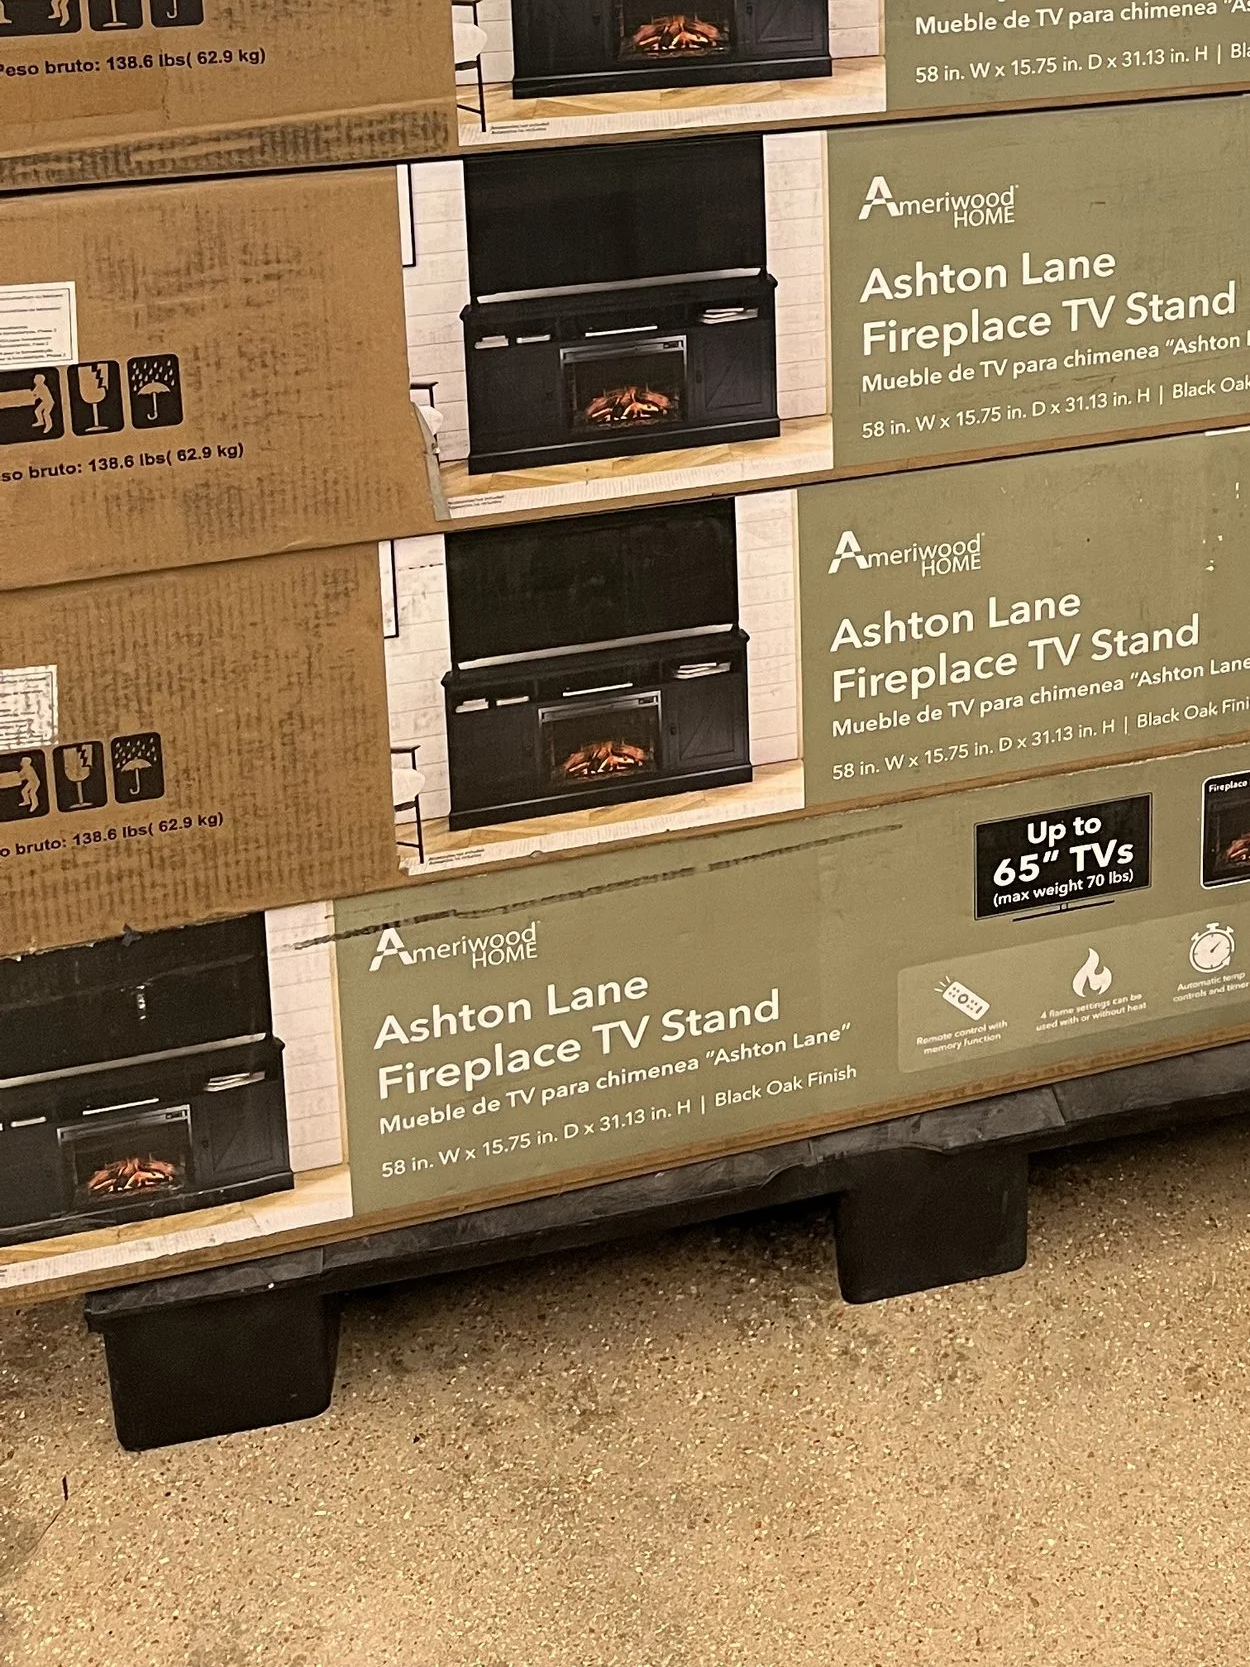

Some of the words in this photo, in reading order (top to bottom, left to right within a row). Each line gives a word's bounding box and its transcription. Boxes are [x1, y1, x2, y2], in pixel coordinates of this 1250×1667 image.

[916, 12, 997, 34] Mueble
[1004, 10, 1030, 28] de
[1035, 8, 1063, 26] TV
[1069, 4, 1113, 29] para
[1121, 2, 1217, 20] chimenea
[45, 59, 100, 74] bruto:
[107, 55, 153, 70] 138.6
[197, 50, 232, 64] 62.9
[239, 48, 265, 64] kg)
[916, 66, 938, 83] 58
[945, 66, 964, 80] in.
[970, 62, 990, 78] W
[995, 66, 1005, 77] x
[1011, 58, 1057, 75] 15.75
[1063, 57, 1082, 71] in.
[1089, 54, 1102, 69] D
[1107, 57, 1117, 68] x
[1122, 49, 1164, 67] 31.13
[1171, 48, 1189, 63] in.
[1196, 46, 1207, 61] H
[859, 176, 1014, 220] Ameriwood
[953, 205, 1015, 228] HOME
[860, 262, 1006, 302] Ashton
[1023, 253, 1115, 285] Lane
[864, 309, 1051, 356] Fireplace
[1062, 296, 1115, 331] TV
[1126, 281, 1235, 325] Stand
[863, 367, 942, 392] Mueble
[949, 363, 974, 382] de
[980, 359, 1007, 377] TV
[1014, 358, 1057, 379] para
[1064, 346, 1158, 368] chimenea
[29, 464, 81, 478] bruto:
[88, 455, 134, 472] 138.6
[177, 447, 211, 461] 62.9
[217, 442, 243, 459] kg)
[828, 531, 982, 575] Ameriwood
[921, 556, 982, 578] HOME
[830, 610, 973, 652] Ashton
[989, 594, 1080, 628] Lane
[833, 652, 1017, 702] Fireplace
[1028, 634, 1080, 669] TV
[1091, 613, 1198, 660] Stand
[1209, 780, 1247, 792] Fireplace
[16, 839, 66, 855] bruto:
[72, 828, 117, 847] 138.6
[159, 817, 192, 832] 62.9
[198, 812, 223, 827] kg)
[1028, 821, 1066, 847] Up
[1073, 817, 1101, 835] to
[1070, 839, 1133, 872] TVs
[993, 891, 1029, 908] (max
[1033, 879, 1083, 899] weight
[1087, 874, 1104, 888] 70
[1110, 869, 1133, 884] lbs)
[369, 921, 537, 973] Ameriwood
[471, 945, 538, 970] HOME
[373, 997, 531, 1051] Ashton
[548, 977, 648, 1015] Lane
[378, 1037, 581, 1101] Fireplace
[592, 1016, 649, 1054] TV
[662, 989, 778, 1041] Stand
